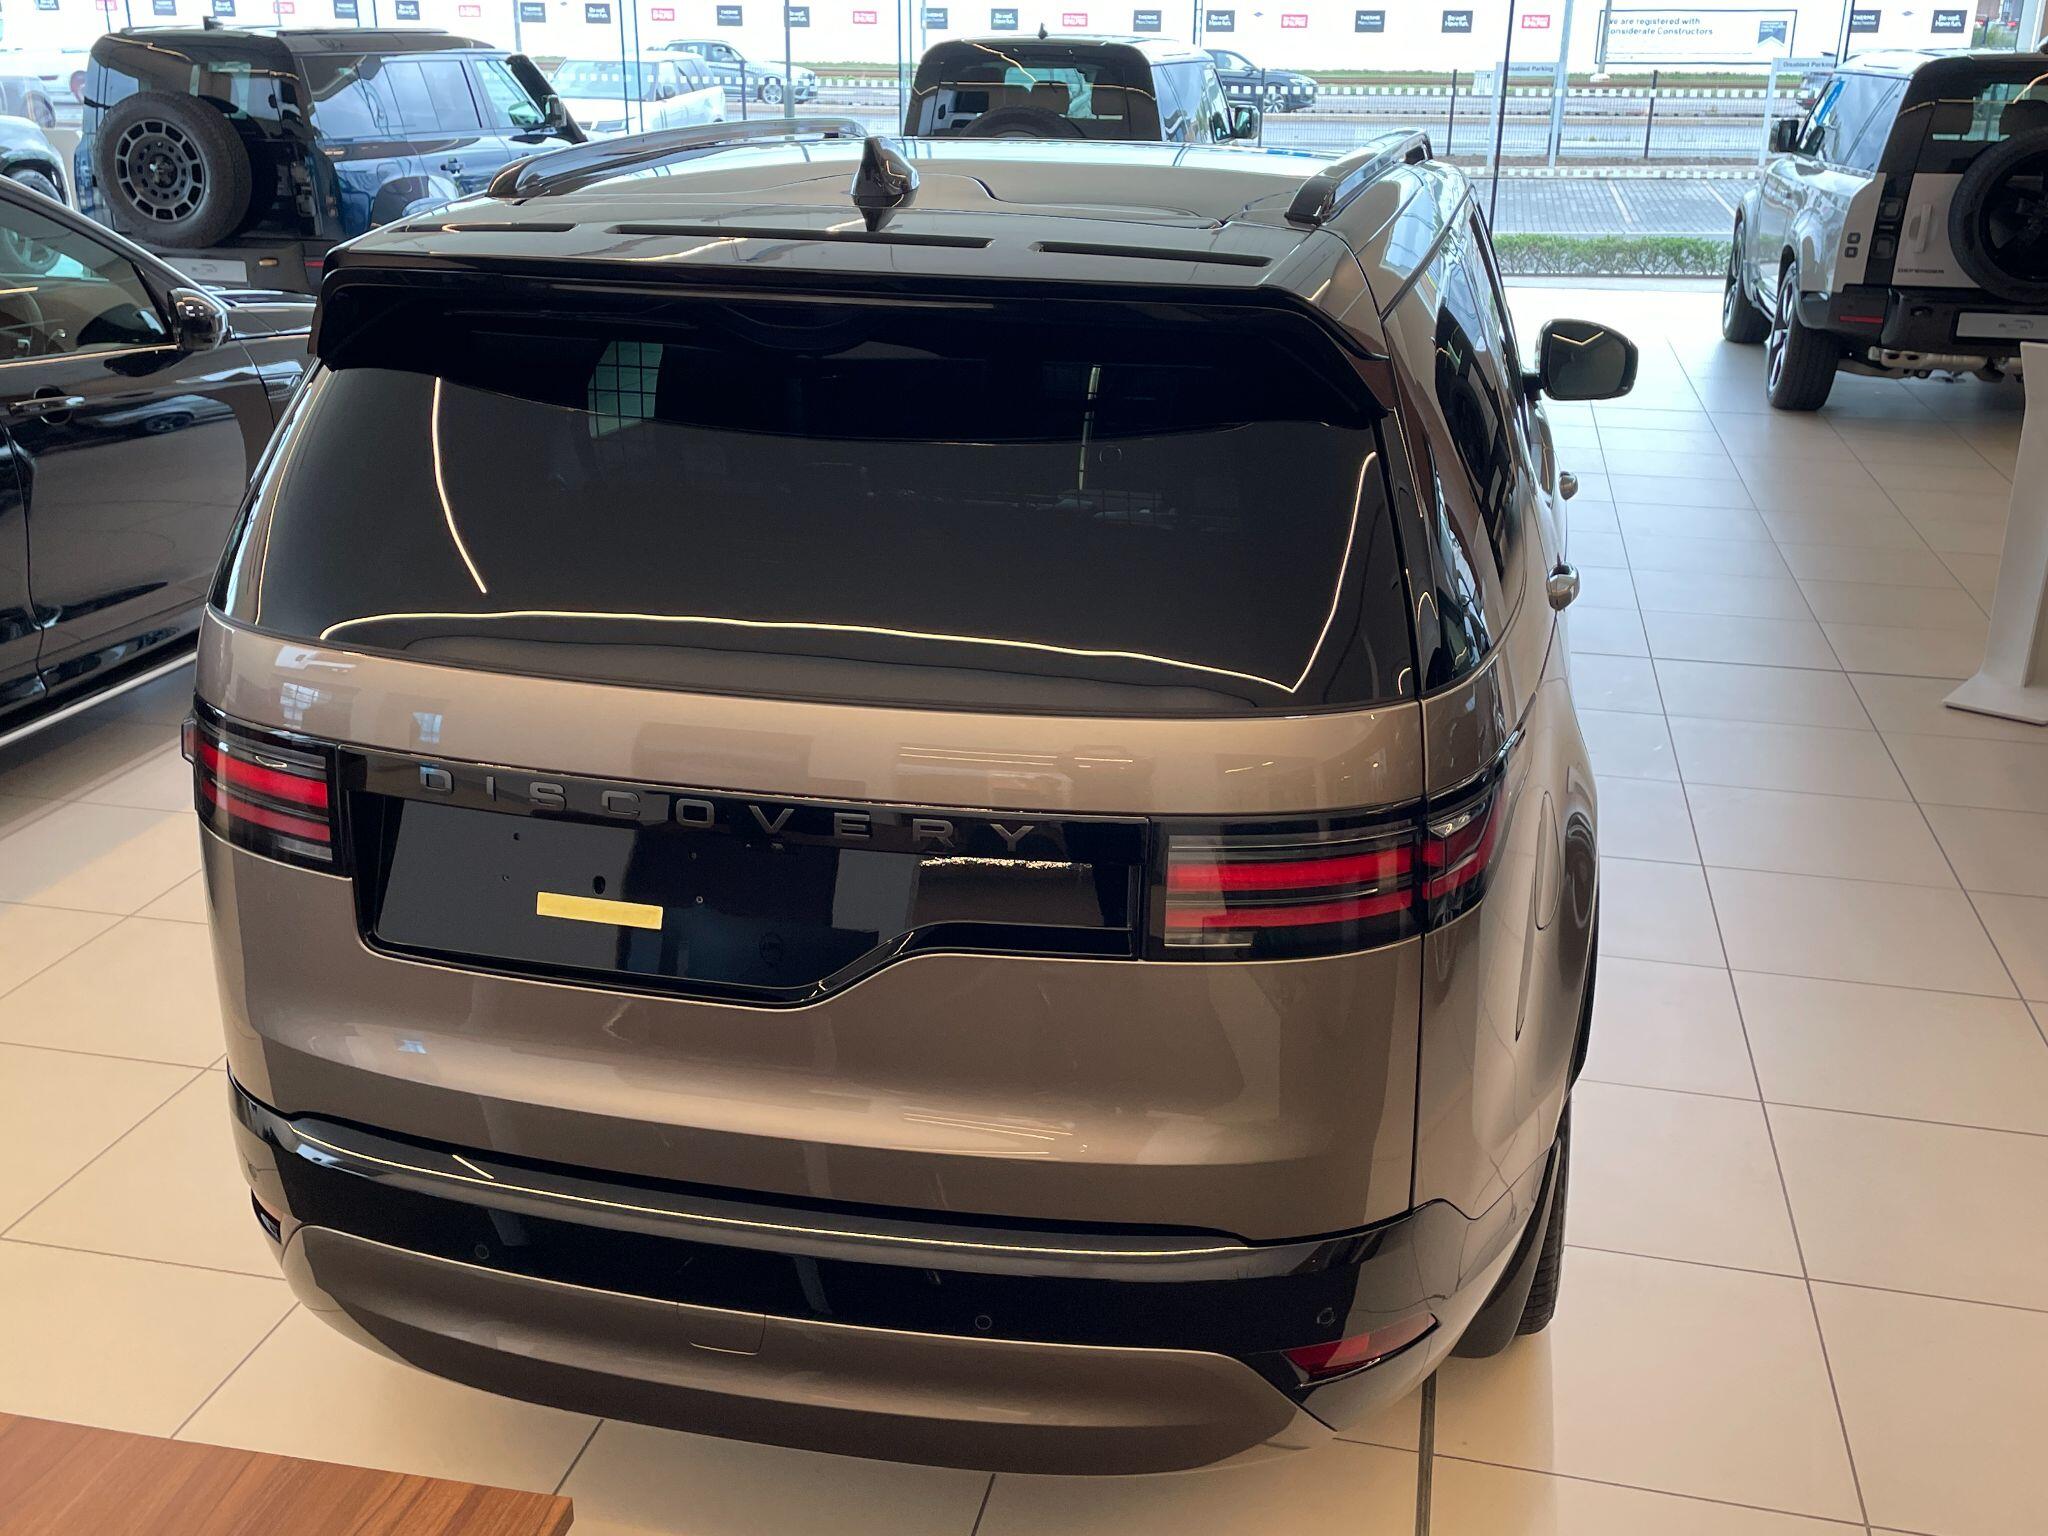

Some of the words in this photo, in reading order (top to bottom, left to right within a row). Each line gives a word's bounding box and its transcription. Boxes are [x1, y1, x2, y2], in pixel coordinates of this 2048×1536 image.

[1636, 18, 1680, 26] registered
[1608, 27, 1656, 35] onsiderate
[1657, 27, 1713, 35] Constructors
[419, 765, 1035, 853] DISCOVERY
